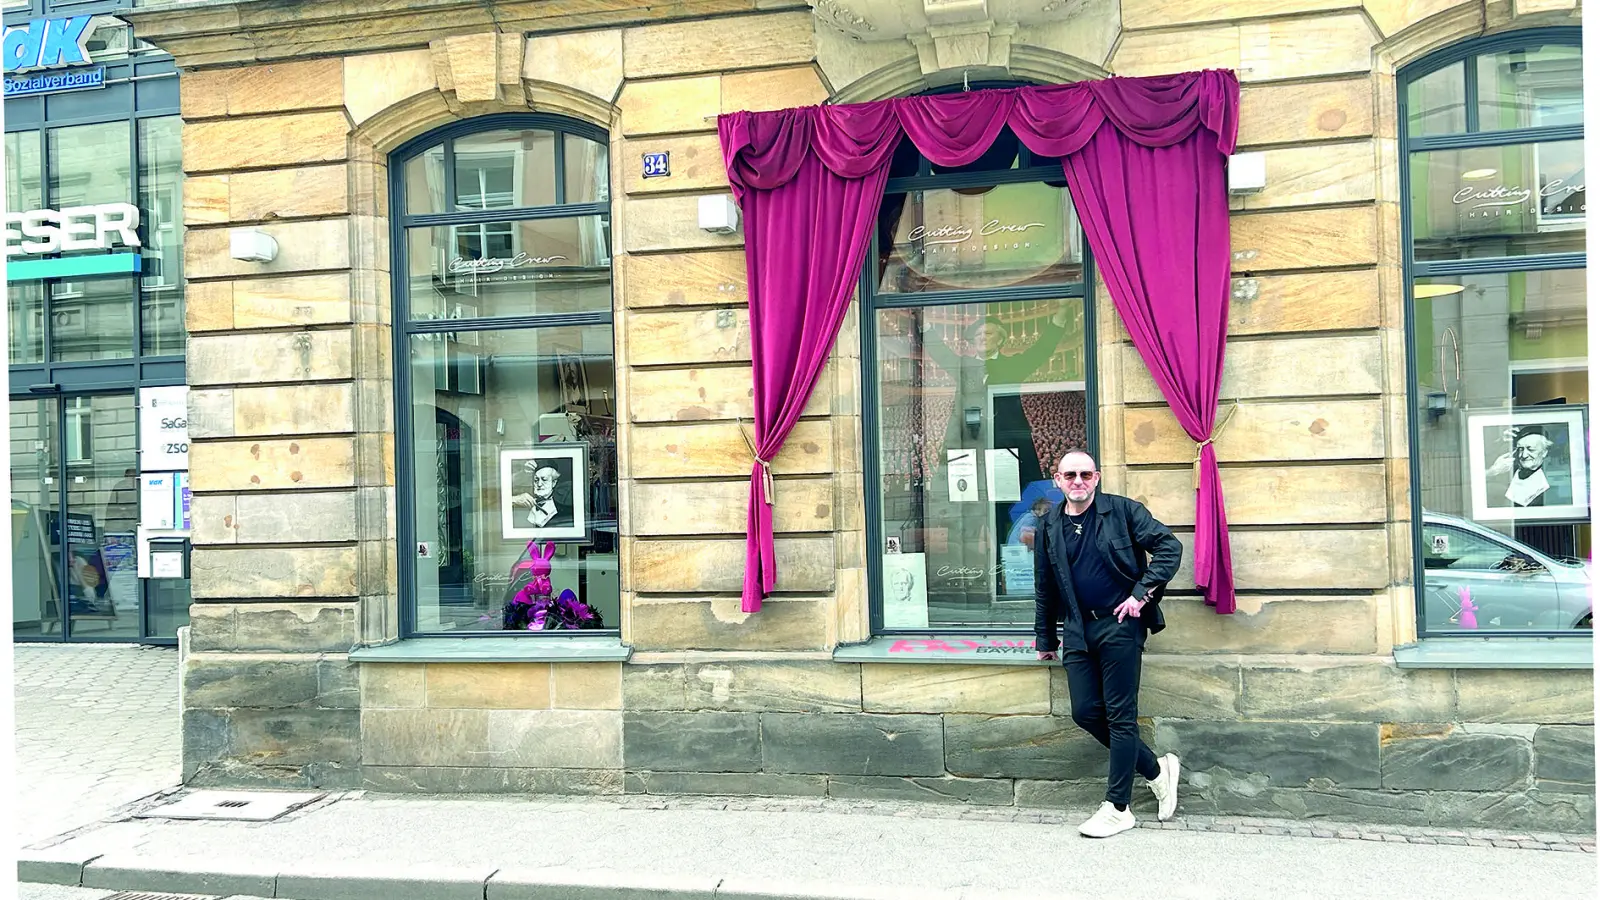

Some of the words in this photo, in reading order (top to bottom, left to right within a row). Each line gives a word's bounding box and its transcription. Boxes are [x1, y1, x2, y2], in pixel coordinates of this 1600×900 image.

[3, 15, 92, 72] dK
[4, 67, 102, 92] Sozialverband
[645, 155, 667, 174] 34
[1453, 184, 1531, 209] Cutting
[1469, 209, 1512, 218] HAIR
[907, 224, 973, 246] Cutting
[980, 219, 1045, 236] Crew
[921, 246, 957, 255] HAIR
[971, 242, 1030, 252] DESIGN
[448, 256, 504, 276] Cutting
[510, 252, 566, 267] Crew
[936, 565, 984, 581] Cutting
